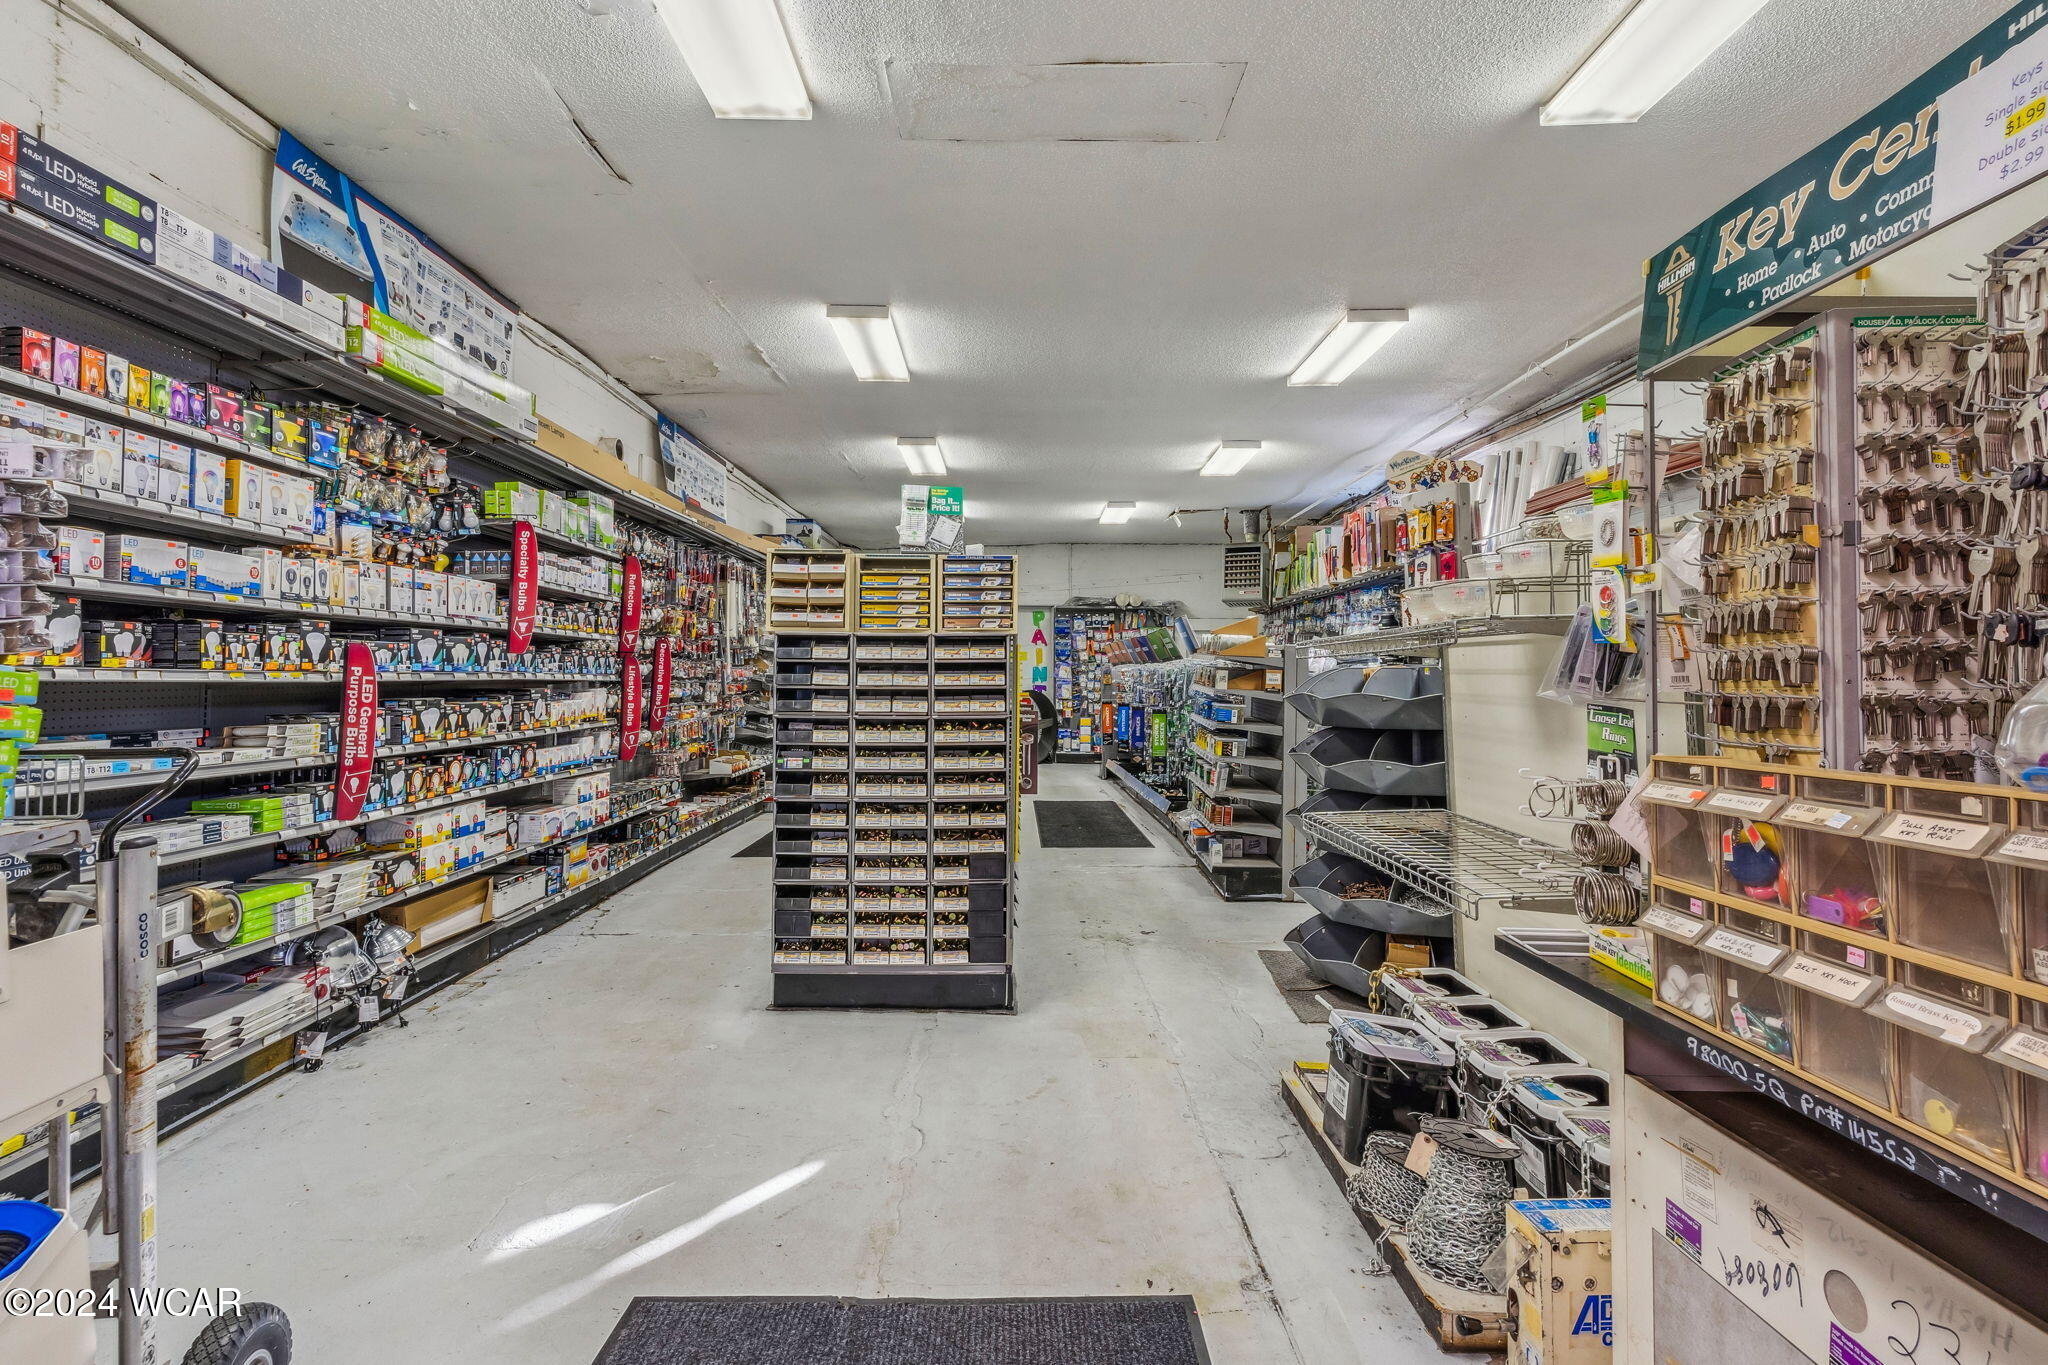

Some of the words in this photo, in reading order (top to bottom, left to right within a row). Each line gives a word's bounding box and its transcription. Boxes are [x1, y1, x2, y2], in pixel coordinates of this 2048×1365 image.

[2011, 60, 2044, 91] Keys
[1984, 89, 2026, 128] Single
[2004, 101, 2047, 138] $1.99
[1978, 138, 2026, 171] Double
[1999, 146, 2044, 180] $2.99
[45, 155, 76, 184] LED
[44, 190, 75, 218] LED
[160, 206, 170, 217] T8
[160, 215, 169, 226] T8
[176, 223, 188, 236] T12
[379, 217, 404, 240] PATIO
[1713, 180, 1816, 275] Key
[1737, 260, 1779, 294] Home
[1806, 222, 1847, 257] Auto
[1657, 256, 1697, 294] HILLMAN
[1760, 260, 1822, 306] Padlock
[208, 384, 220, 394] LED
[274, 409, 285, 418] LED
[931, 496, 946, 506] Bag
[931, 504, 951, 512] Price
[63, 528, 78, 539] LED
[123, 537, 139, 547] LED
[191, 549, 205, 559] LED
[518, 530, 530, 580] Specialty
[518, 582, 528, 612] Bulbs
[626, 574, 636, 617] Reflectors
[658, 643, 666, 684] Decorative
[347, 666, 363, 723] Purpose
[361, 676, 373, 704] LED
[628, 665, 636, 699] Lifestyle
[655, 684, 665, 707] Bulbs
[627, 699, 635, 726] Bulbs
[1589, 709, 1617, 725] Loose
[1618, 712, 1634, 729] Leaf
[357, 706, 372, 758] General
[1602, 727, 1627, 745] Rings
[344, 727, 359, 767] Bulbs
[99, 765, 111, 773] T12
[1899, 829, 1920, 838] KEY
[1900, 819, 1924, 830] PULL
[1928, 824, 1966, 835] APART
[138, 912, 149, 959] COSCO
[1594, 940, 1608, 953] COLOR
[1794, 962, 1818, 974] BELT
[1821, 970, 1837, 981] KEY
[1838, 975, 1860, 989] HOOK
[1889, 994, 1917, 1010] Round
[1918, 1003, 1941, 1018] Brass
[1941, 1011, 1960, 1025] Key
